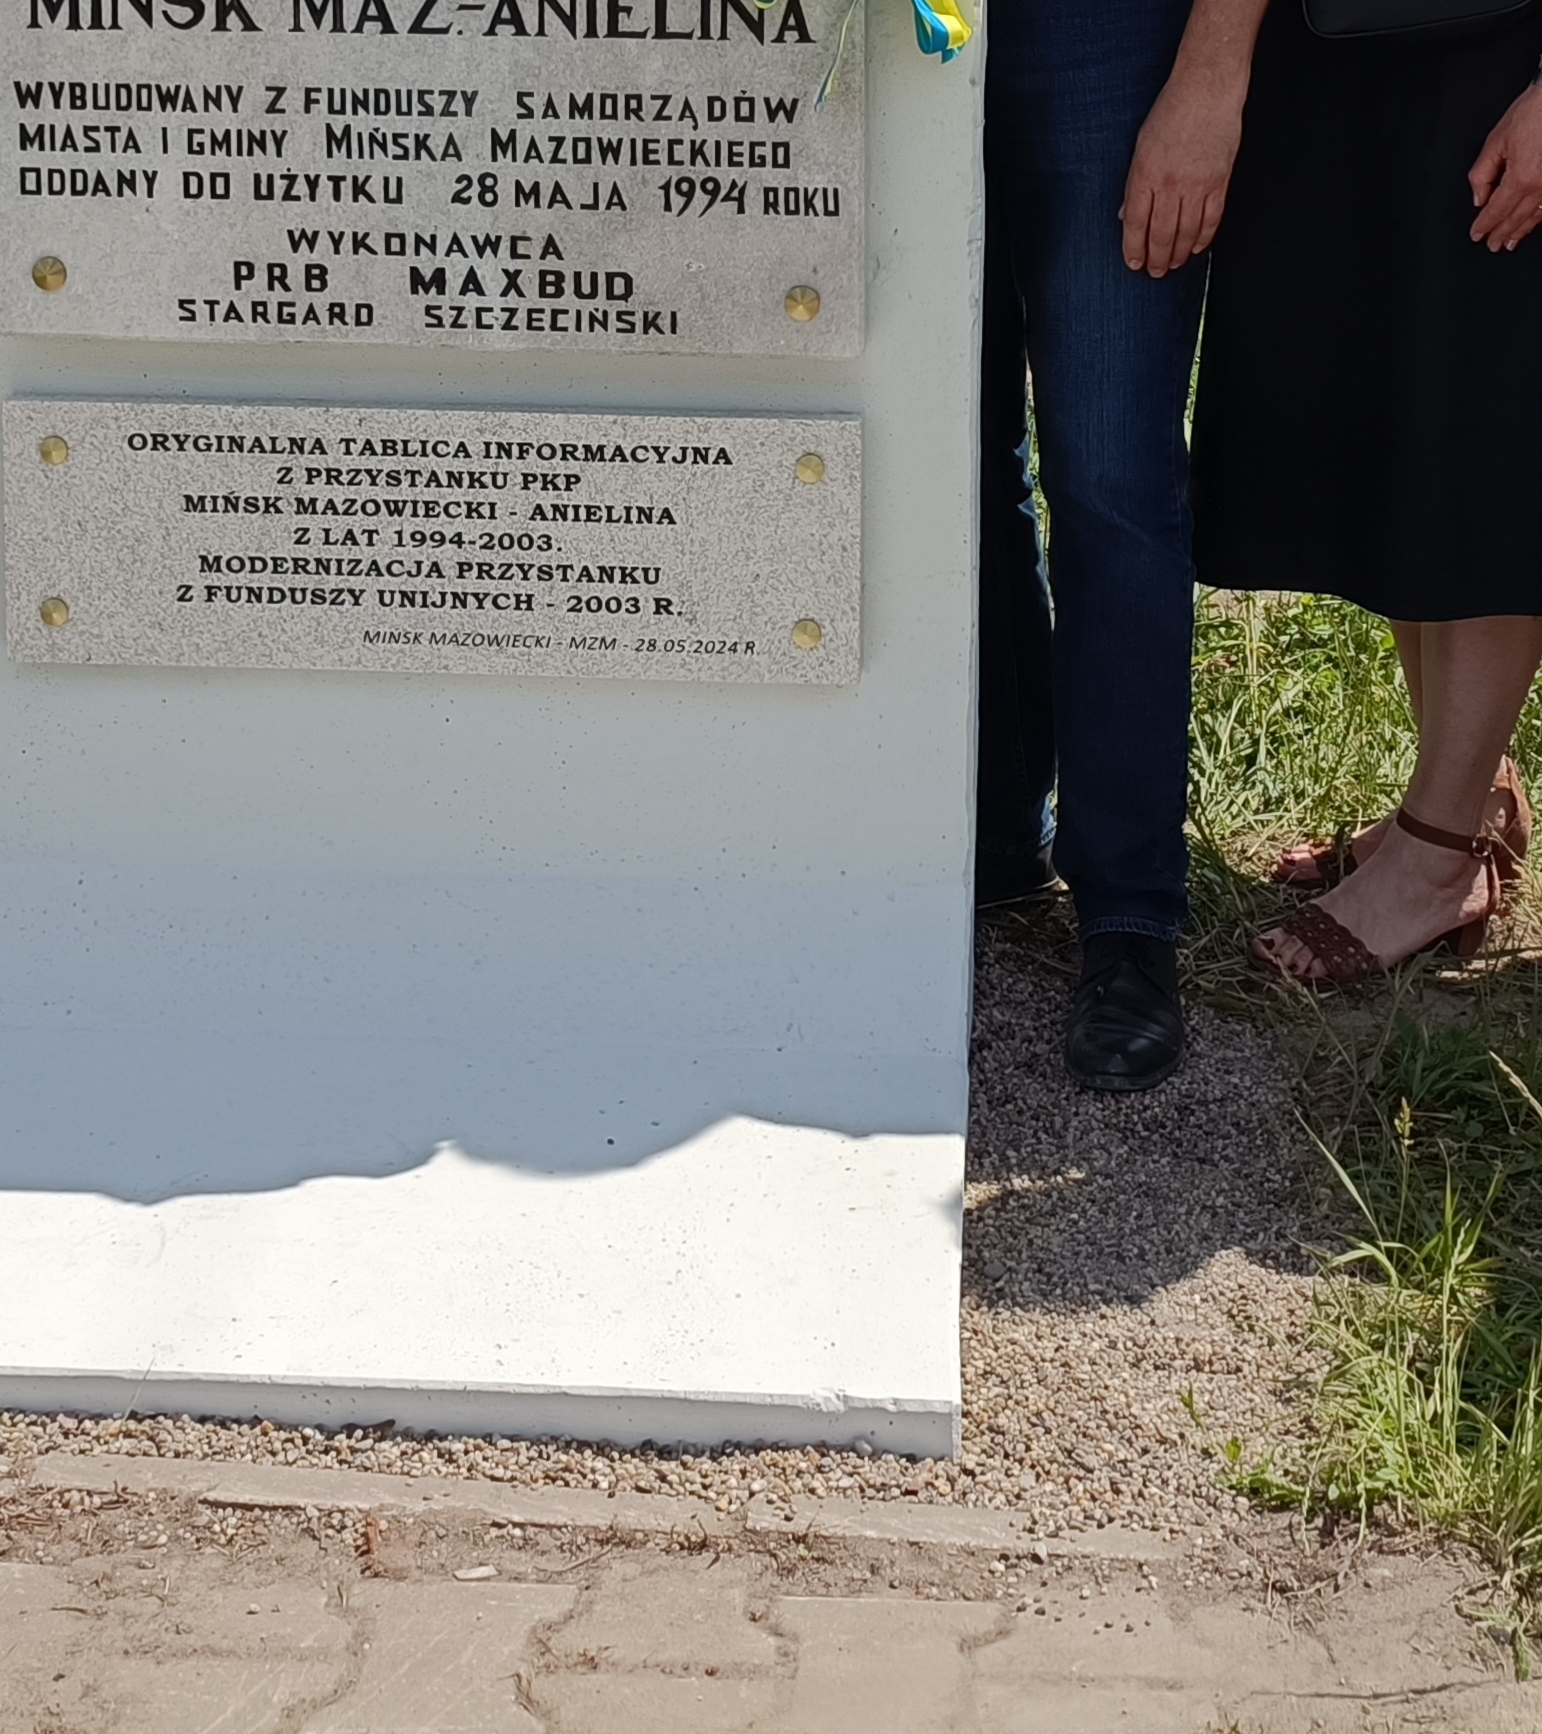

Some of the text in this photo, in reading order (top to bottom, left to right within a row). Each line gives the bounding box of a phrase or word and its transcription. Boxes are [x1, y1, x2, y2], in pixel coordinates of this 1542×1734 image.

[14, 80, 800, 131] WYBUDOWANY Z FUNDUSZY SAMORZĄDÓW
[18, 122, 792, 170] MIASTA I GMINY MIŃSKA MAZOWIECKIEGO
[19, 166, 841, 219] ODDANY DO UŻYTKU 28 MAJA 1994 ROKU
[287, 227, 565, 262] WYKONAWCA
[233, 260, 634, 304] PRB MAXBUD
[177, 298, 678, 336] STARGARD SZCZECIŃSKI
[126, 432, 734, 466] ORYGINALNA TABLICA INFORMACYJNA
[276, 466, 582, 492] Z PRZYSTANKU PKP
[183, 491, 284, 515] MIŃSK
[294, 496, 499, 520] MAZOWIECKI
[528, 503, 678, 526] ANIELINA
[293, 527, 563, 552] Z LAT 1994-2003.
[198, 554, 662, 585] MODERNIZACJA PRZYSTANKU
[176, 584, 194, 603] Z
[204, 584, 367, 606] FUNDUSZY
[377, 589, 536, 612] UNIJNYCH
[566, 595, 642, 615] 2003
[652, 597, 684, 616] R.
[429, 632, 552, 650] MAZOWIECKI
[569, 636, 618, 651] MZM
